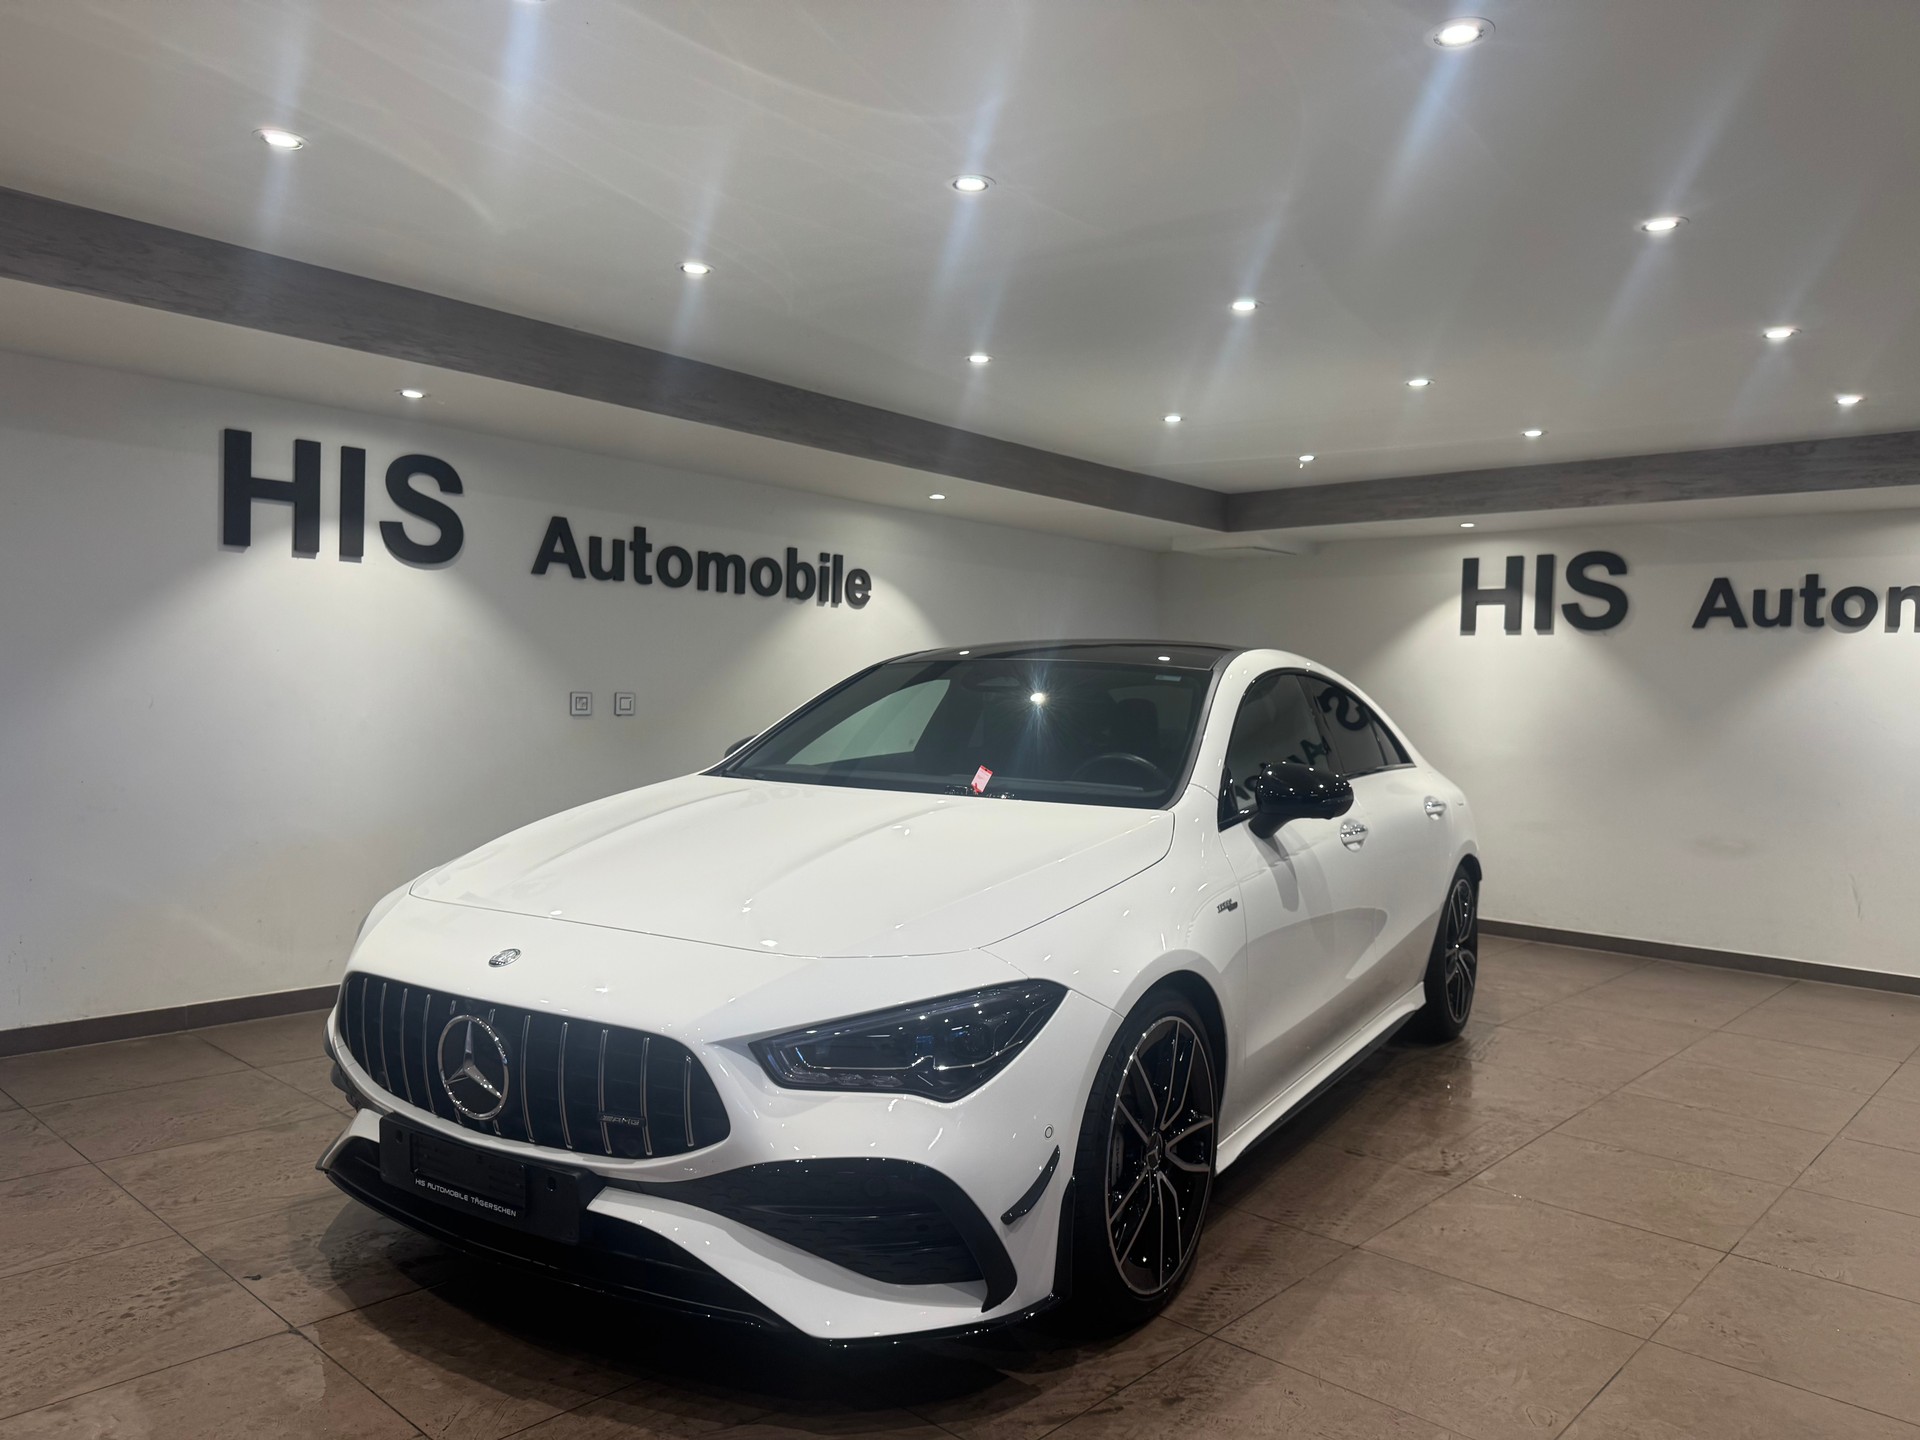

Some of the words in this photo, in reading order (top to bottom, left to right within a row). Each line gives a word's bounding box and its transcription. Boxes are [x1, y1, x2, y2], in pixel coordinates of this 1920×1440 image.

[221, 428, 465, 567] HIS
[531, 515, 872, 606] Automobile
[1461, 551, 1629, 632] HIS
[415, 1178, 426, 1188] HIS
[426, 1182, 469, 1202] AUTOMOBILE
